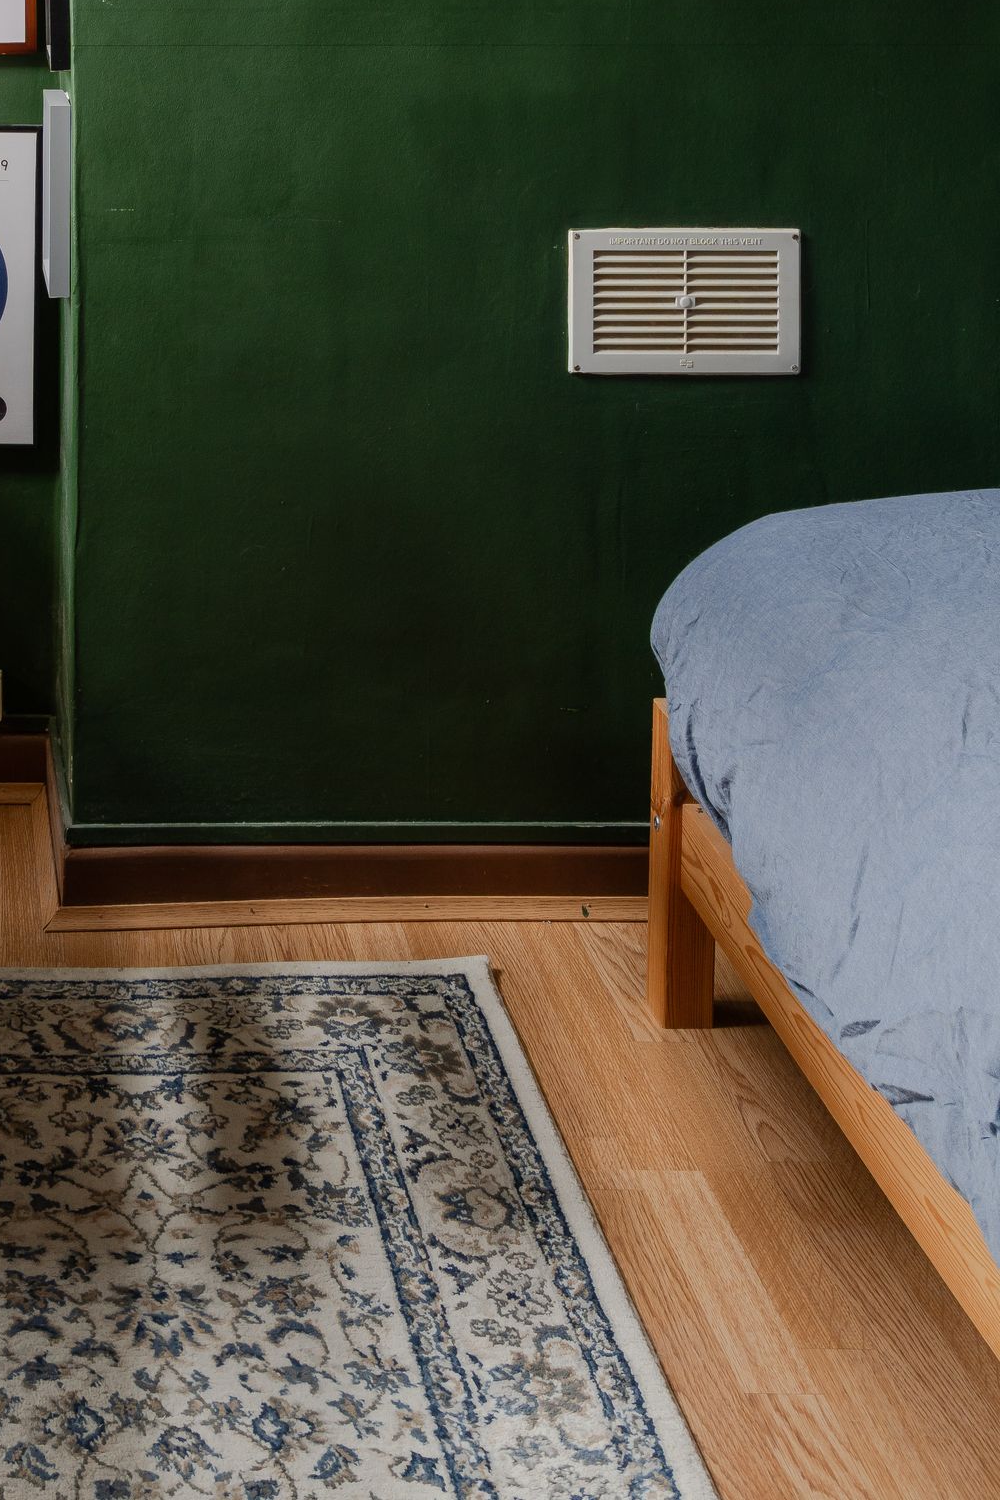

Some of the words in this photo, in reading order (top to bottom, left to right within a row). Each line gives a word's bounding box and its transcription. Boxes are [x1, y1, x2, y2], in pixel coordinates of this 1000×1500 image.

[609, 238, 656, 246] IMPORTANT
[658, 238, 670, 246] DO
[670, 238, 688, 246] NOT
[690, 238, 718, 246] BLOCK
[720, 238, 738, 246] THIS
[739, 238, 762, 246] VENT
